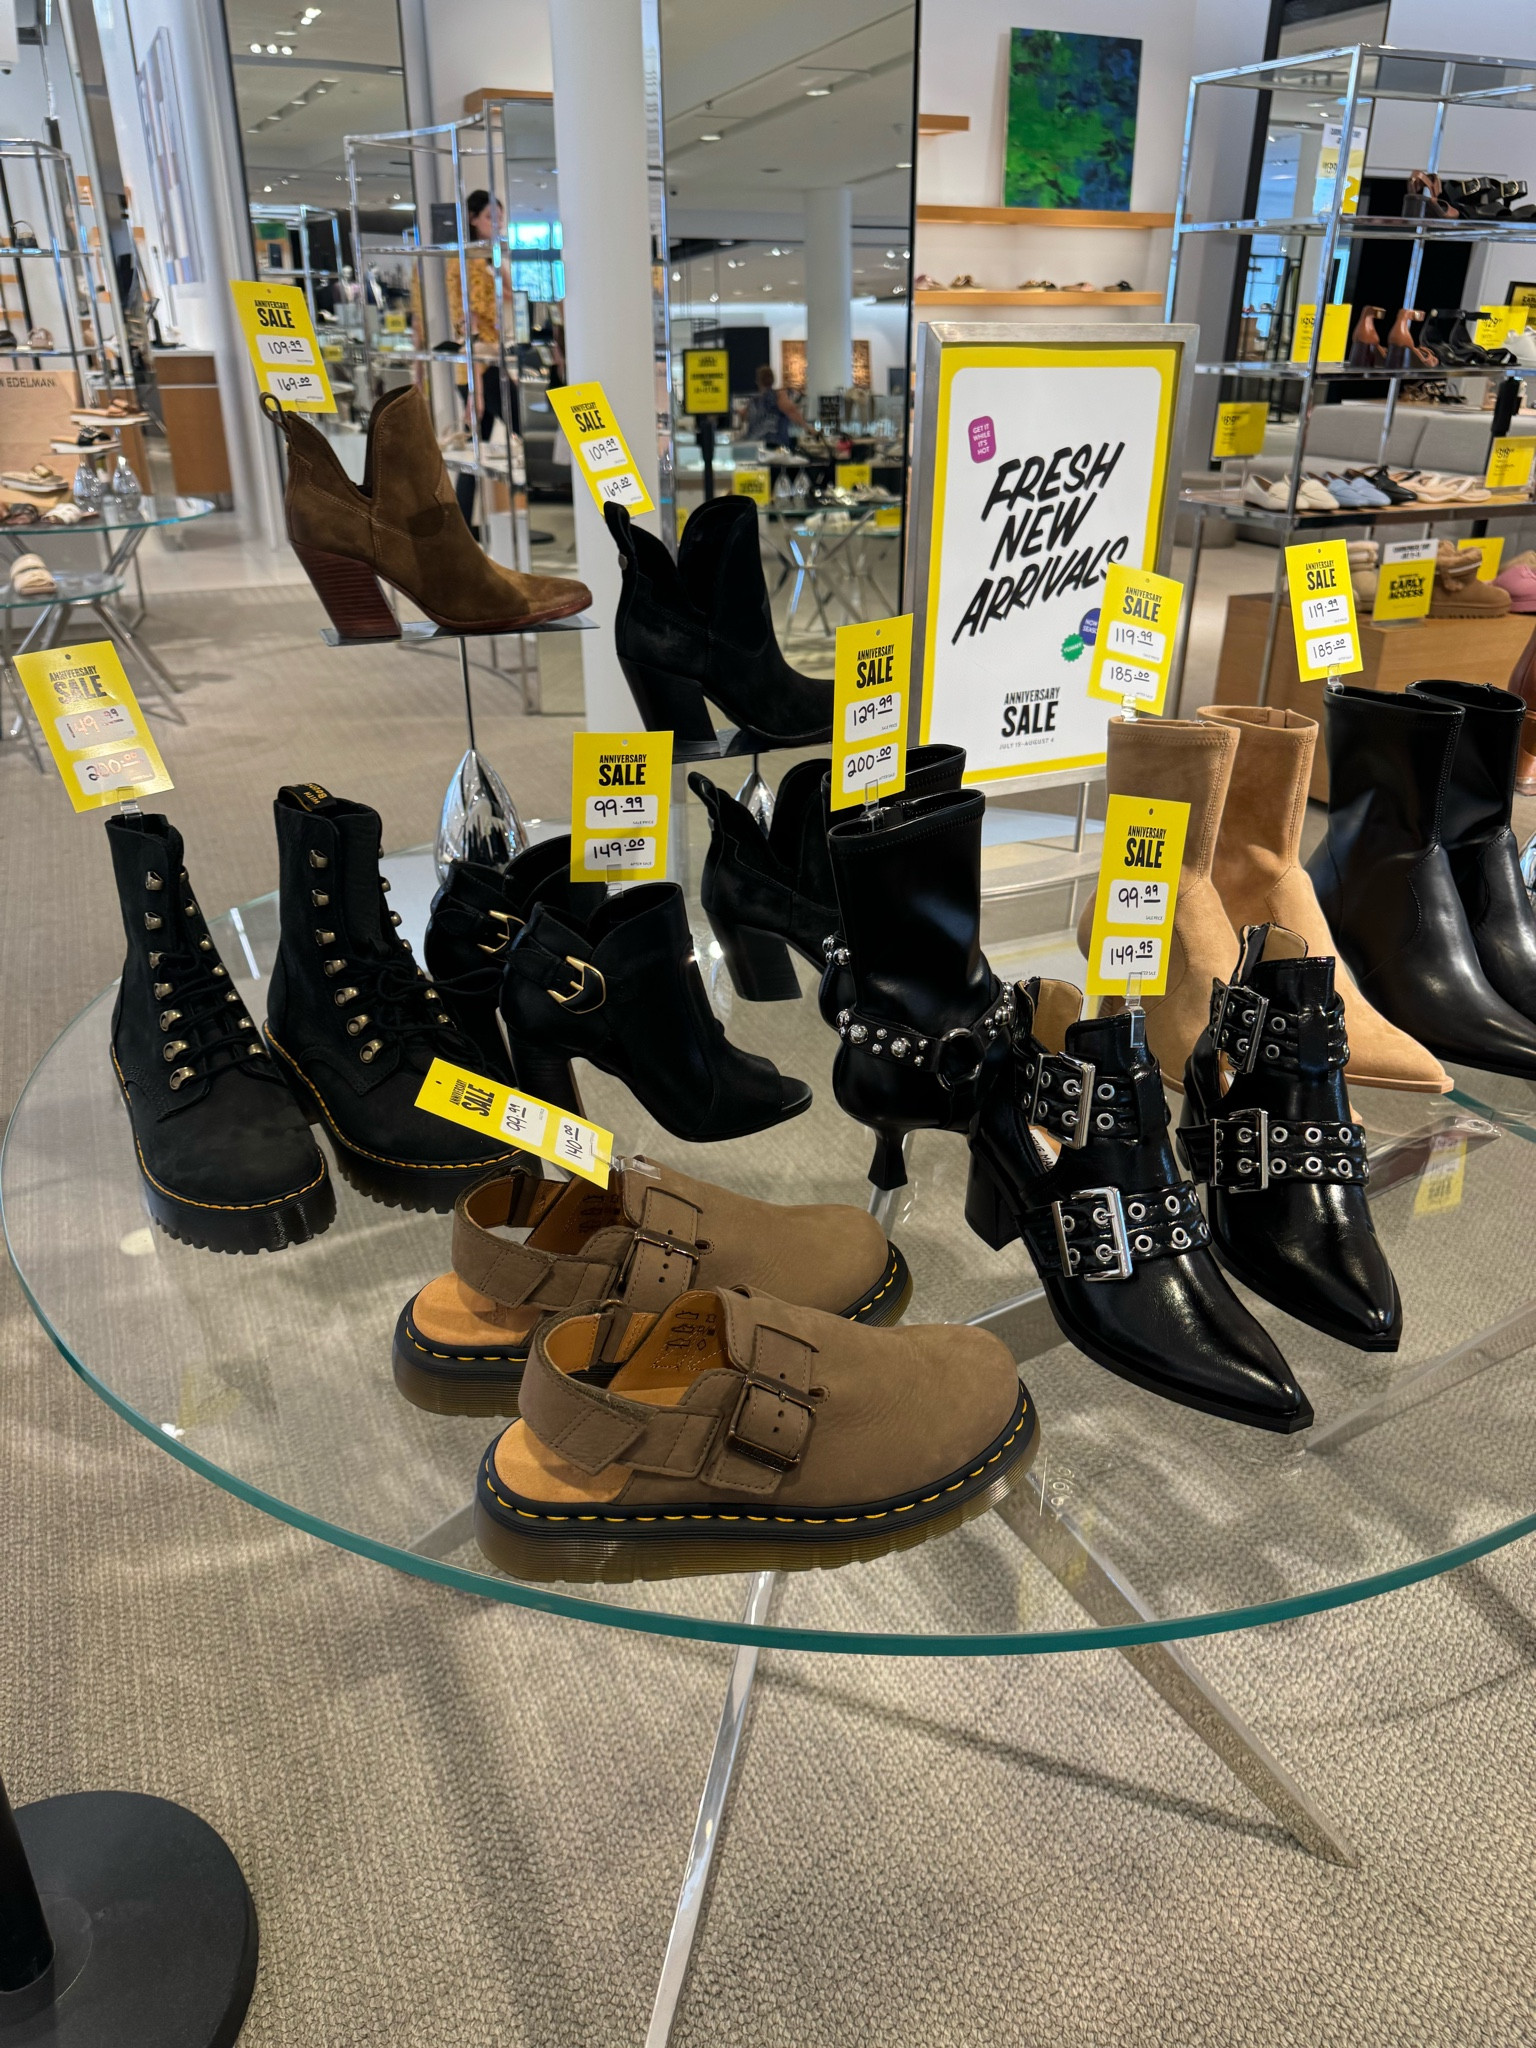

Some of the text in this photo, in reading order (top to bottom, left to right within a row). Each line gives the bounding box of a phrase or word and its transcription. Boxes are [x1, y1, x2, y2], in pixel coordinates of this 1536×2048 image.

[254, 300, 289, 309] ANNIVERSARY
[257, 308, 295, 328] SALE
[268, 340, 303, 354] 109.99
[6, 377, 56, 388] EDELMAN
[277, 377, 312, 391] 169.00
[574, 410, 606, 432] SALE
[973, 426, 983, 434] GET
[973, 431, 991, 441] WHILE
[588, 438, 619, 461] 109.99
[977, 446, 990, 455] HOT
[603, 477, 632, 498] 169.00
[981, 441, 1126, 522] FRESH
[989, 491, 1098, 571] NEW
[1305, 560, 1334, 571] ANNIVERSARY
[1306, 568, 1337, 591] SALE
[1390, 577, 1425, 591] EARLY
[951, 535, 1130, 646] ARRIVALS
[1125, 586, 1162, 603] ANNIVERSARY
[1388, 587, 1424, 600] ACCESS
[1122, 594, 1161, 623] SALE
[1308, 598, 1339, 619] 119.99
[1115, 627, 1153, 646] 119.99
[857, 644, 894, 661] ANNIVERSARY
[1313, 638, 1346, 659] 185.00
[49, 665, 97, 681] ANNIVERSARY
[856, 656, 893, 689] SALE
[1110, 666, 1150, 683] 185.00
[54, 675, 107, 705] SALE
[1004, 687, 1060, 705] ANNIVERSARY
[853, 694, 892, 726] 129.99
[1001, 701, 1059, 738] SALE
[600, 754, 647, 763] ANNIVERSARY
[847, 746, 892, 778] 200.00
[599, 764, 647, 786] SALE
[594, 797, 645, 817] 99.99
[1128, 825, 1167, 840] ANNIVERSARY
[593, 838, 645, 859] 149.00
[1124, 838, 1165, 869] SALE
[1118, 884, 1161, 909] 99.99
[1110, 940, 1153, 966] 149.95
[449, 1078, 467, 1107] ANNIVERSARY
[461, 1083, 495, 1117] SALE
[506, 1102, 527, 1132] 99.99
[564, 1124, 583, 1159] 140.00
